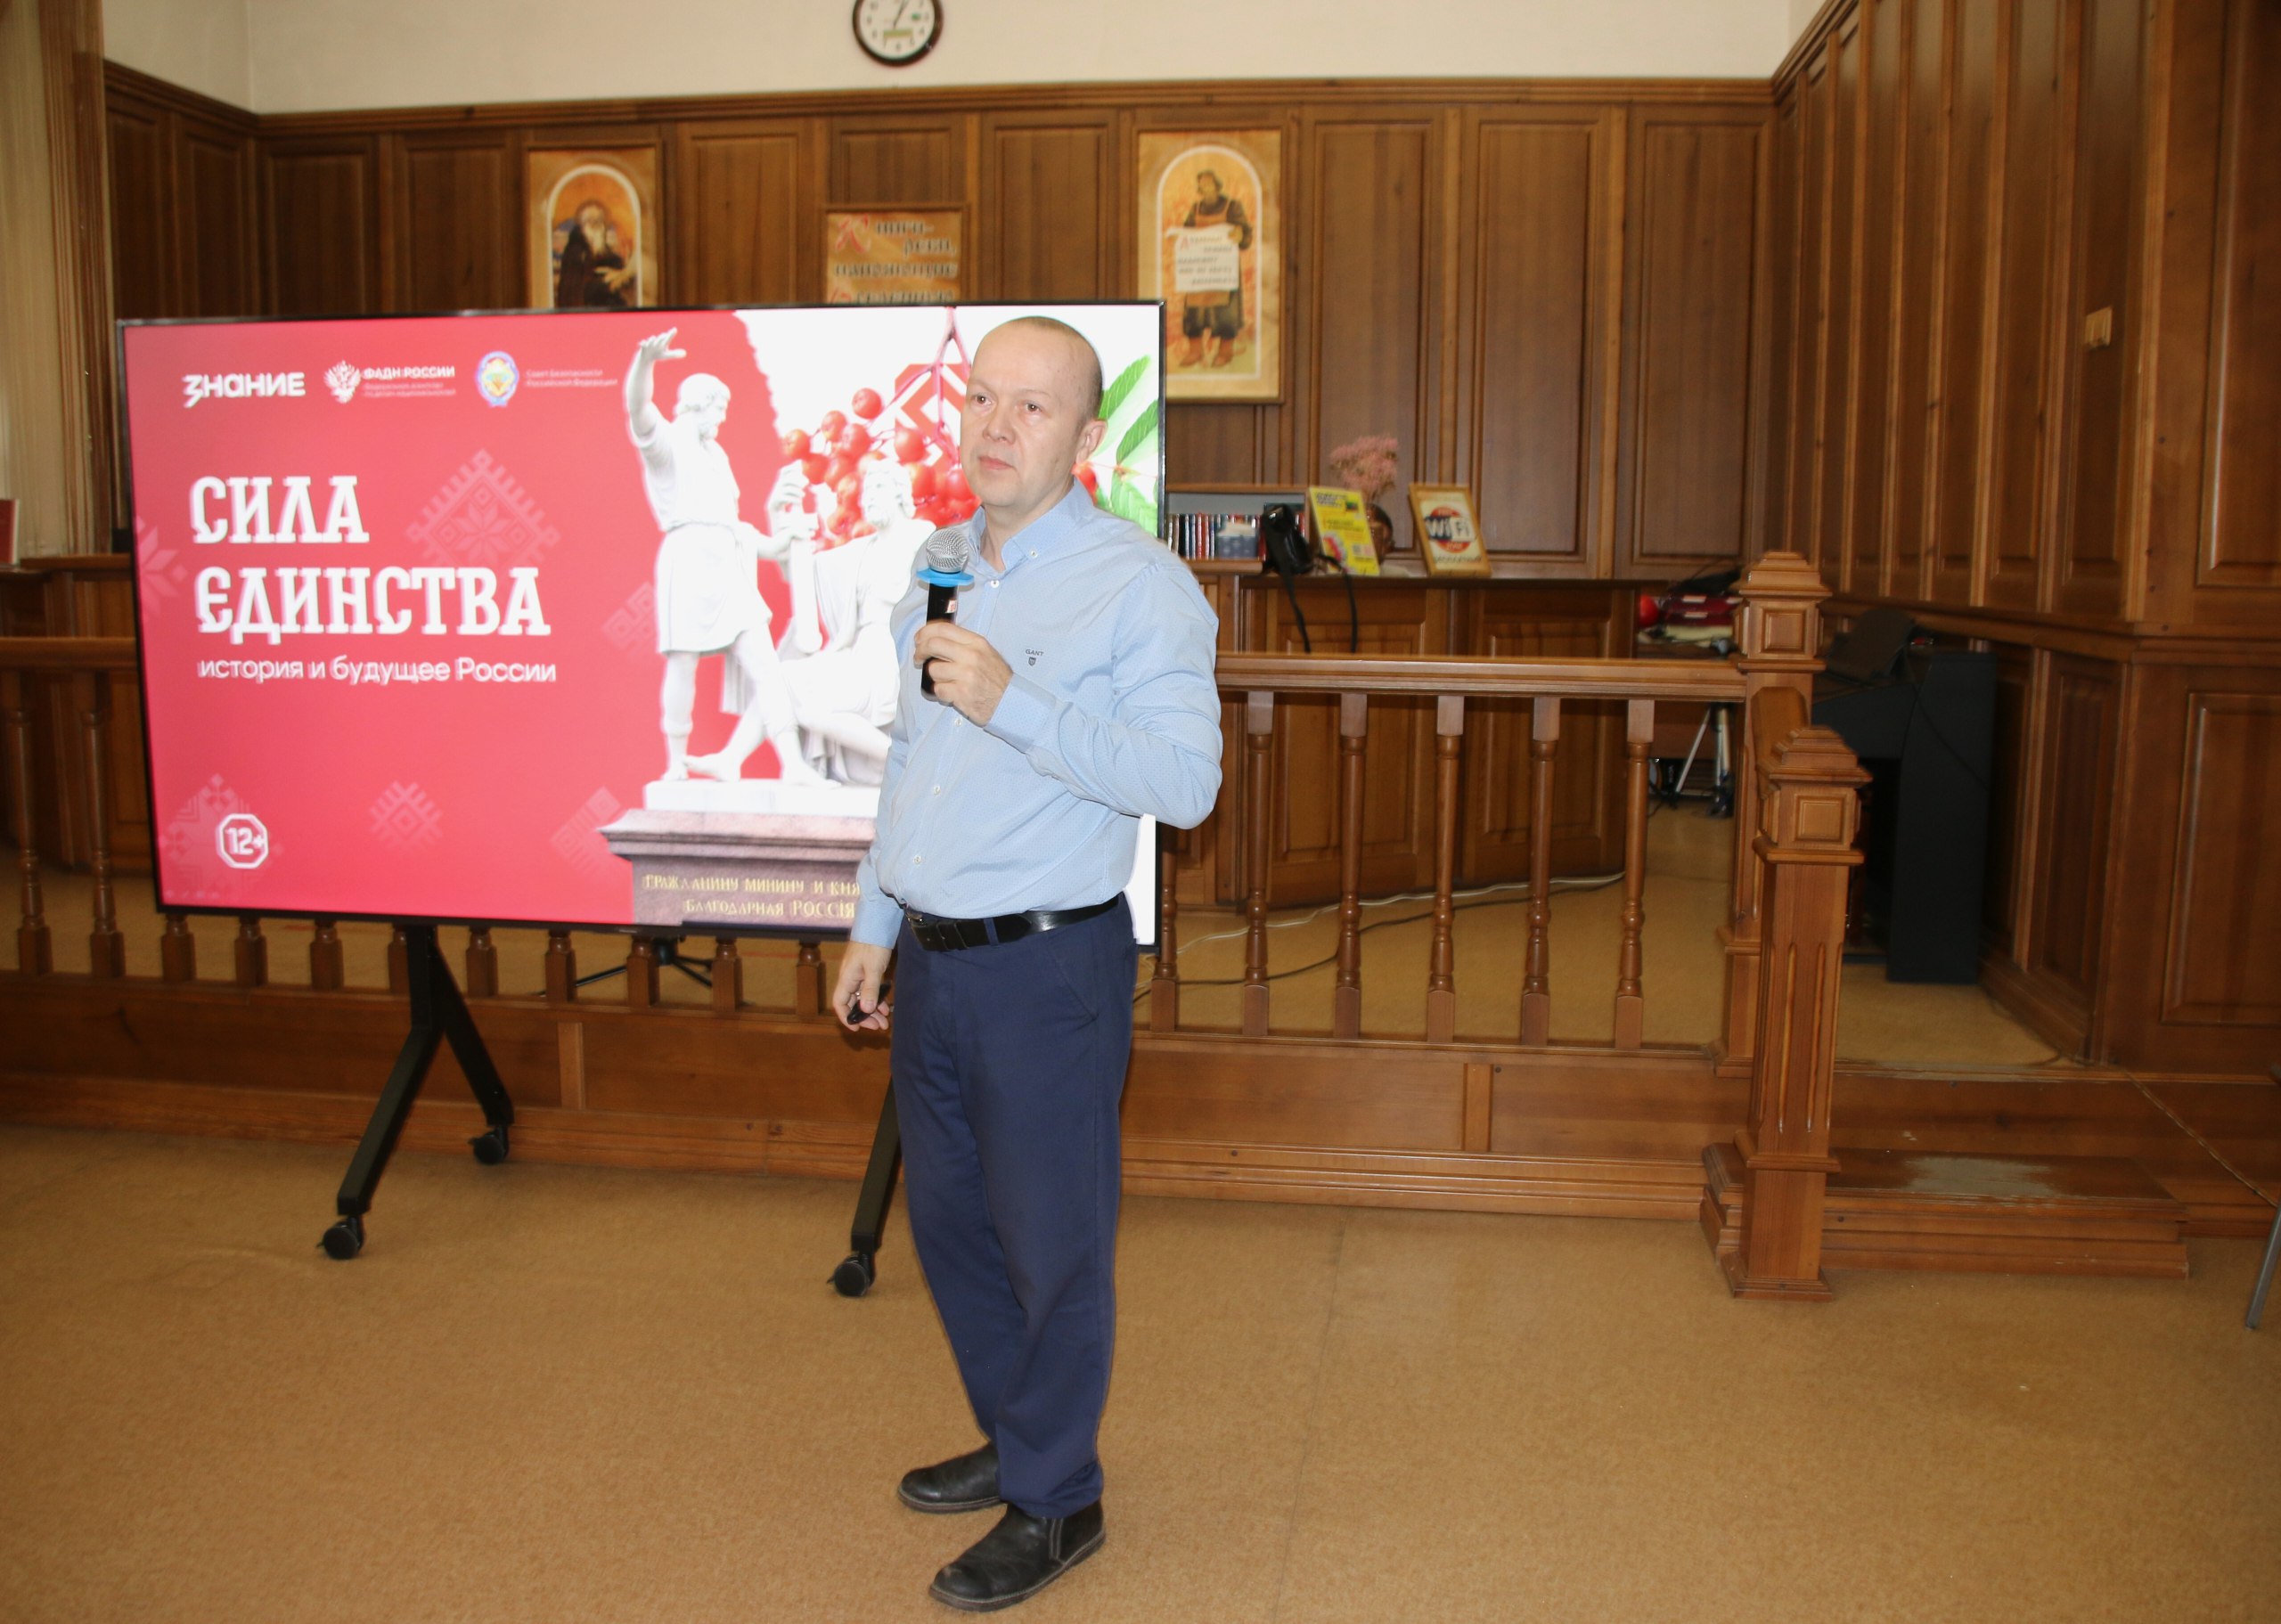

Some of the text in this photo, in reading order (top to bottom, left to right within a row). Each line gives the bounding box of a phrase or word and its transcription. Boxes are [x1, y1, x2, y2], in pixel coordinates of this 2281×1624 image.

[363, 365, 455, 379] ФАДН РОССИИ
[190, 476, 370, 543] СИЛА
[1025, 649, 1044, 657] GANT
[198, 655, 556, 685] история и будущее России
[228, 827, 265, 855] 12+
[744, 877, 804, 893] МИНИНУ
